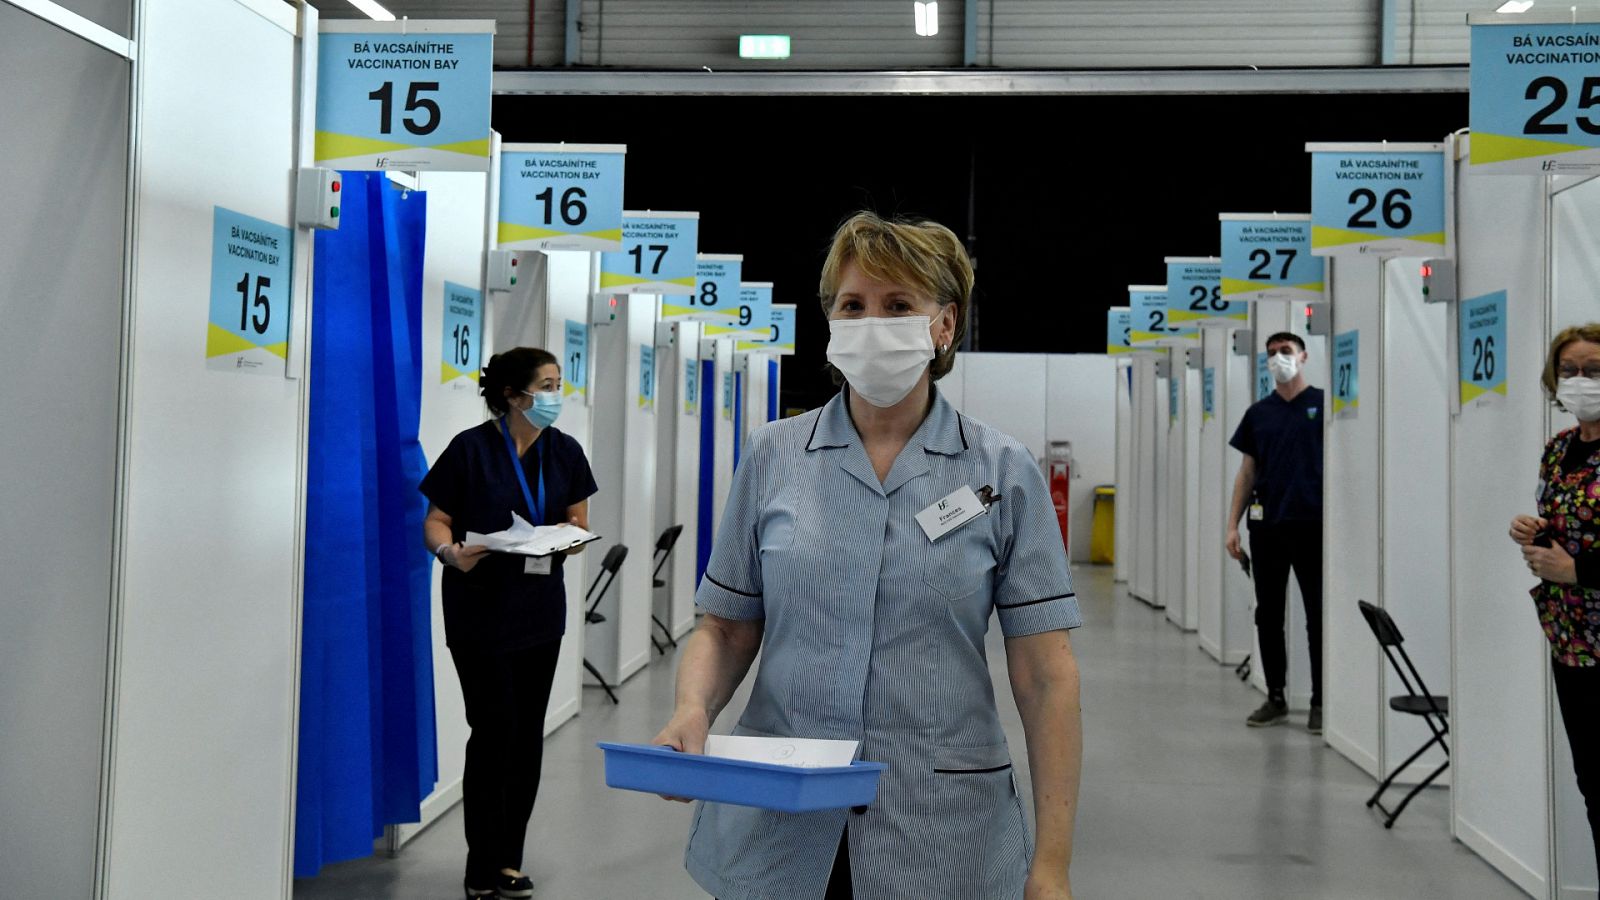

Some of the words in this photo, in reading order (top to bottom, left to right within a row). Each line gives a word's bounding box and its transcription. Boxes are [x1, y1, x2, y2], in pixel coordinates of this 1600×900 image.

[354, 41, 370, 54] BÁ
[374, 41, 454, 54] VACSAÍNÍTHE
[1513, 34, 1533, 47] BÁ
[1536, 33, 1600, 47] VACSAÍN
[348, 59, 431, 69] VACCINATION
[434, 60, 459, 70] BAY
[369, 81, 441, 136] 15
[525, 158, 537, 168] BÁ
[1340, 158, 1353, 168] BÁ
[520, 171, 580, 179] VACCINATION
[582, 171, 601, 180] BAY
[1335, 172, 1401, 180] VACCINATION
[1404, 172, 1424, 180] BAY
[535, 186, 588, 226] 16
[1346, 187, 1412, 230] 26
[227, 244, 268, 264] VACCINATION
[268, 255, 280, 267] BAY
[628, 244, 669, 274] 17
[1248, 248, 1298, 280] 27
[236, 272, 271, 335] 15
[1189, 285, 1230, 311] 28
[453, 324, 470, 366] 16
[1472, 335, 1495, 381] 26
[939, 507, 962, 522] Frances
